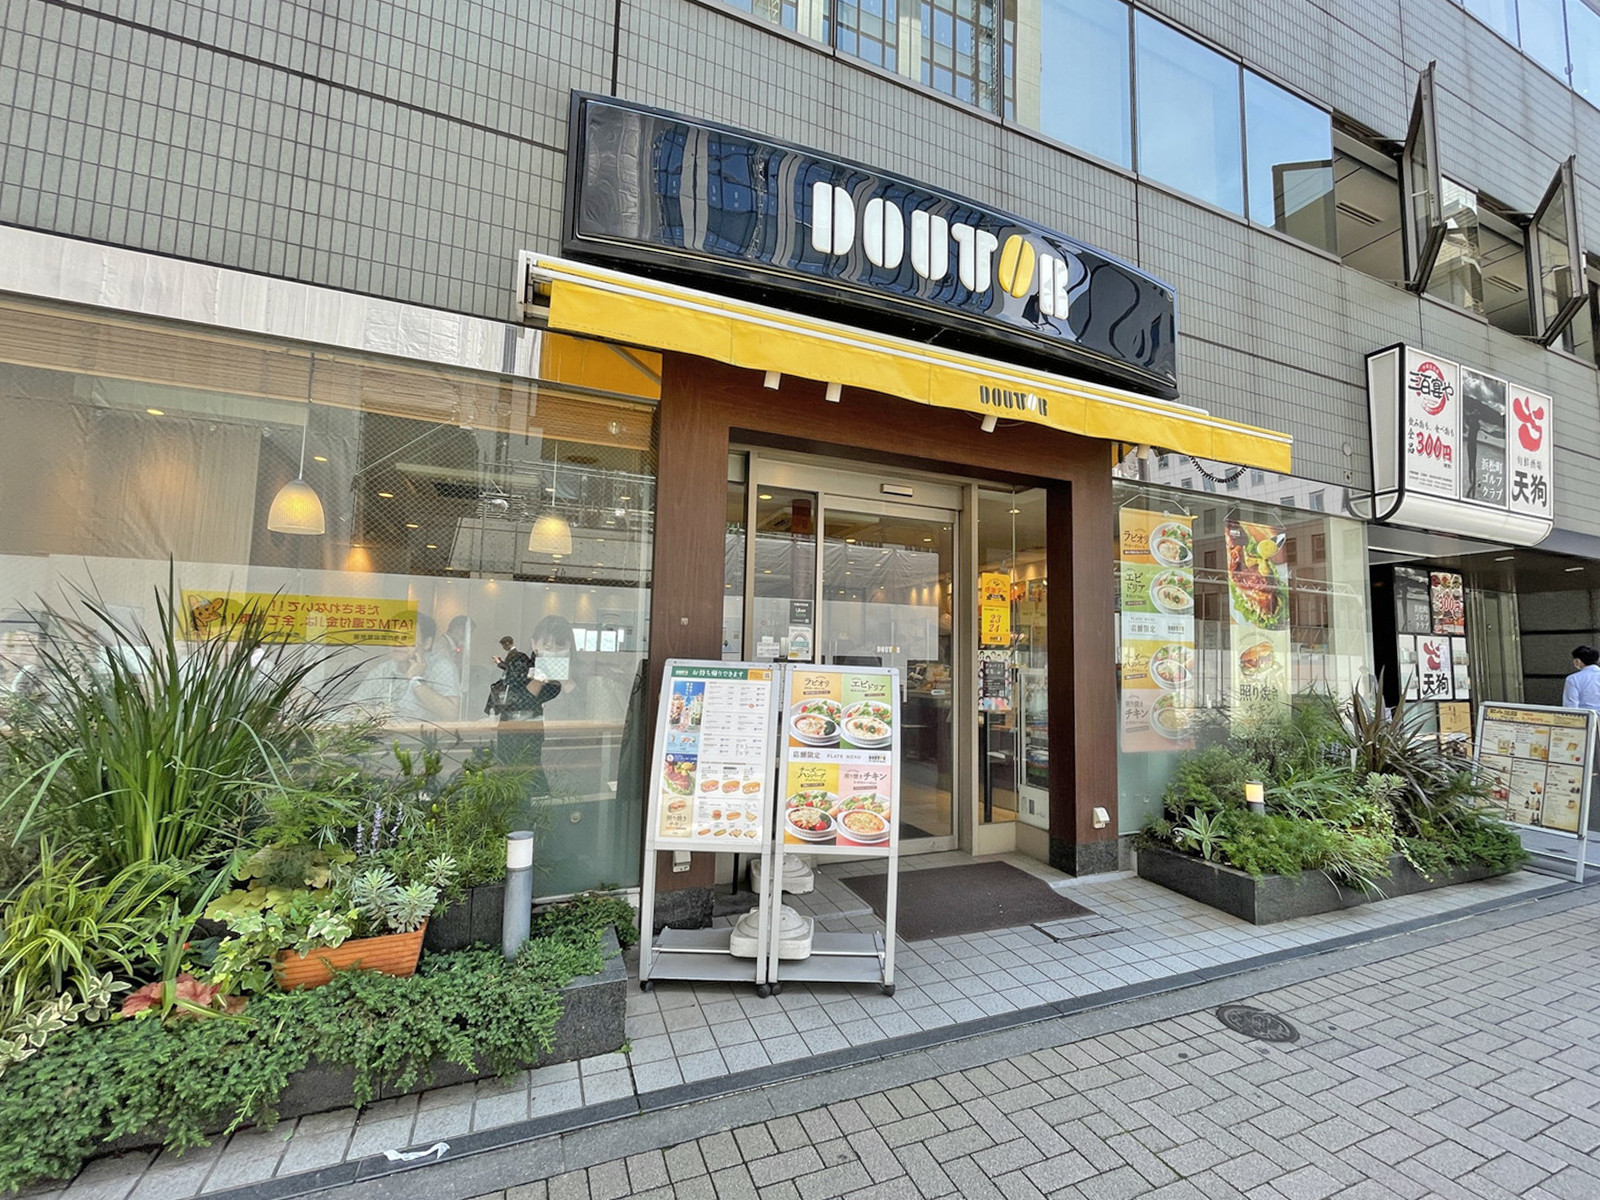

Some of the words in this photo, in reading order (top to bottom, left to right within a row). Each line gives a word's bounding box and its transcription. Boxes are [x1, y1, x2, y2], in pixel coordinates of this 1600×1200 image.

[811, 181, 1069, 320] DOUTOR
[979, 385, 1048, 416] DOUTOR
[1416, 432, 1453, 463] 300円
[1482, 473, 1502, 487] ゴルフ
[1482, 486, 1503, 500] クラブ
[1512, 470, 1548, 508] 天狗
[1123, 530, 1149, 545] ラビオリ
[1125, 572, 1144, 583] エビ
[1126, 583, 1146, 594] ドリア
[990, 615, 1002, 624] 23
[988, 624, 1001, 633] 24
[692, 669, 744, 678] お持ち帰りできます
[804, 678, 830, 687] ラビオリ
[851, 680, 886, 691] エビドリア
[1422, 673, 1449, 695] 天狗
[1240, 684, 1278, 701] 照り焼き
[1125, 708, 1149, 719] チキン
